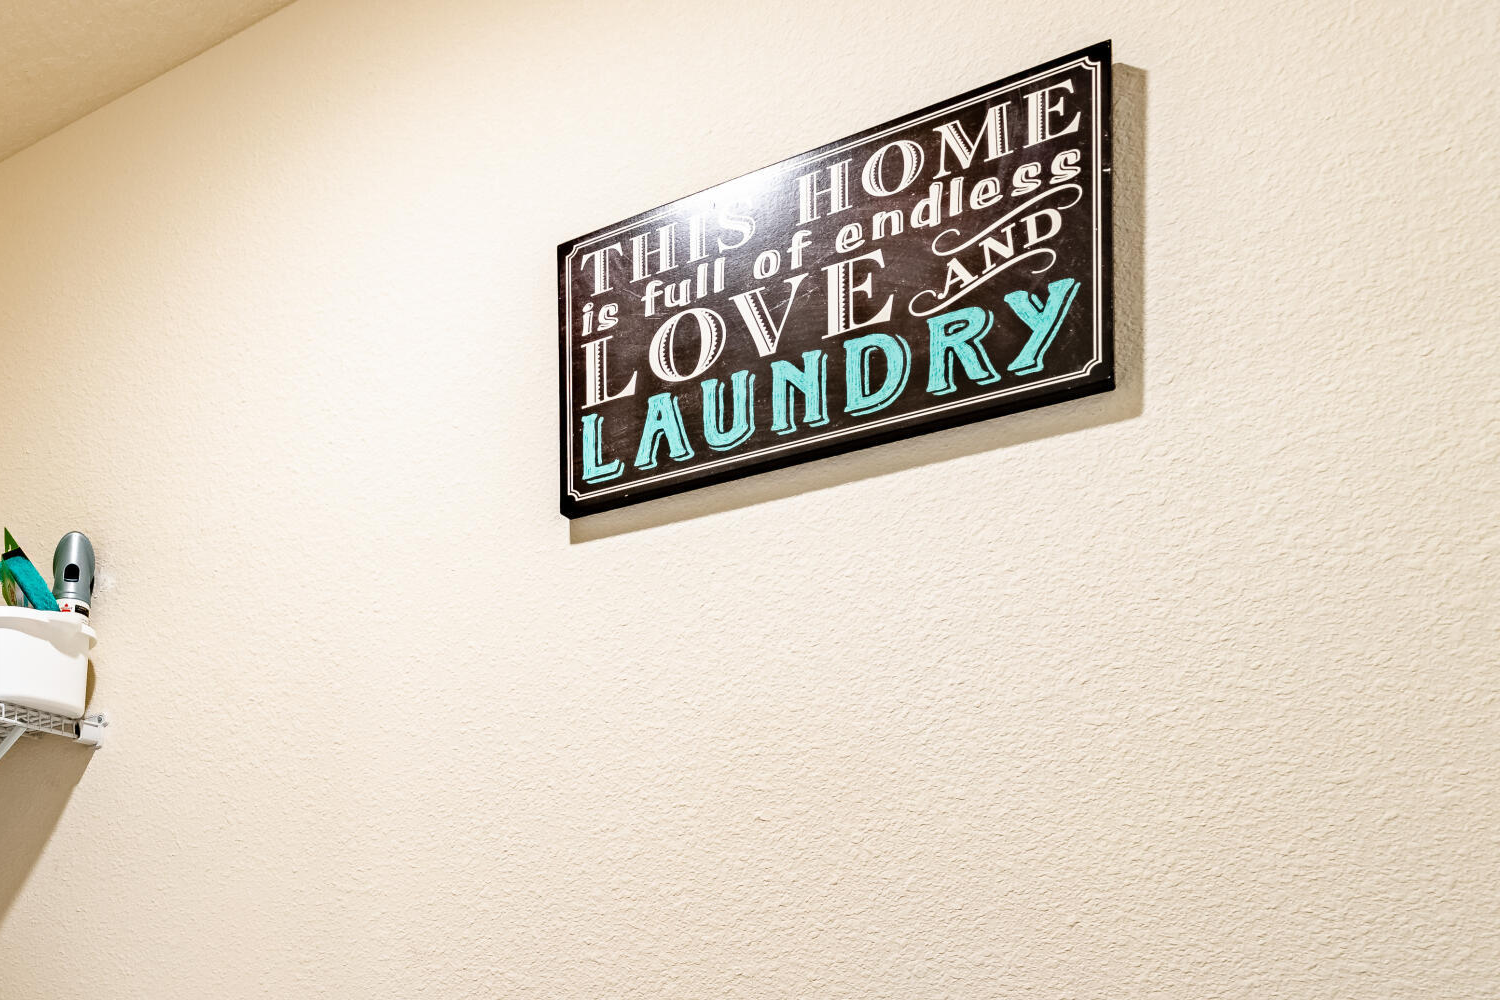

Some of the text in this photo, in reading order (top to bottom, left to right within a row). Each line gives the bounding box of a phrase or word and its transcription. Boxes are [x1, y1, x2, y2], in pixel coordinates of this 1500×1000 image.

[581, 77, 1082, 298] THIS HOME
[581, 148, 1081, 337] is full of endless
[937, 205, 1064, 300] AND
[581, 249, 896, 410] LOVE
[581, 277, 1082, 485] LAUNDRY
